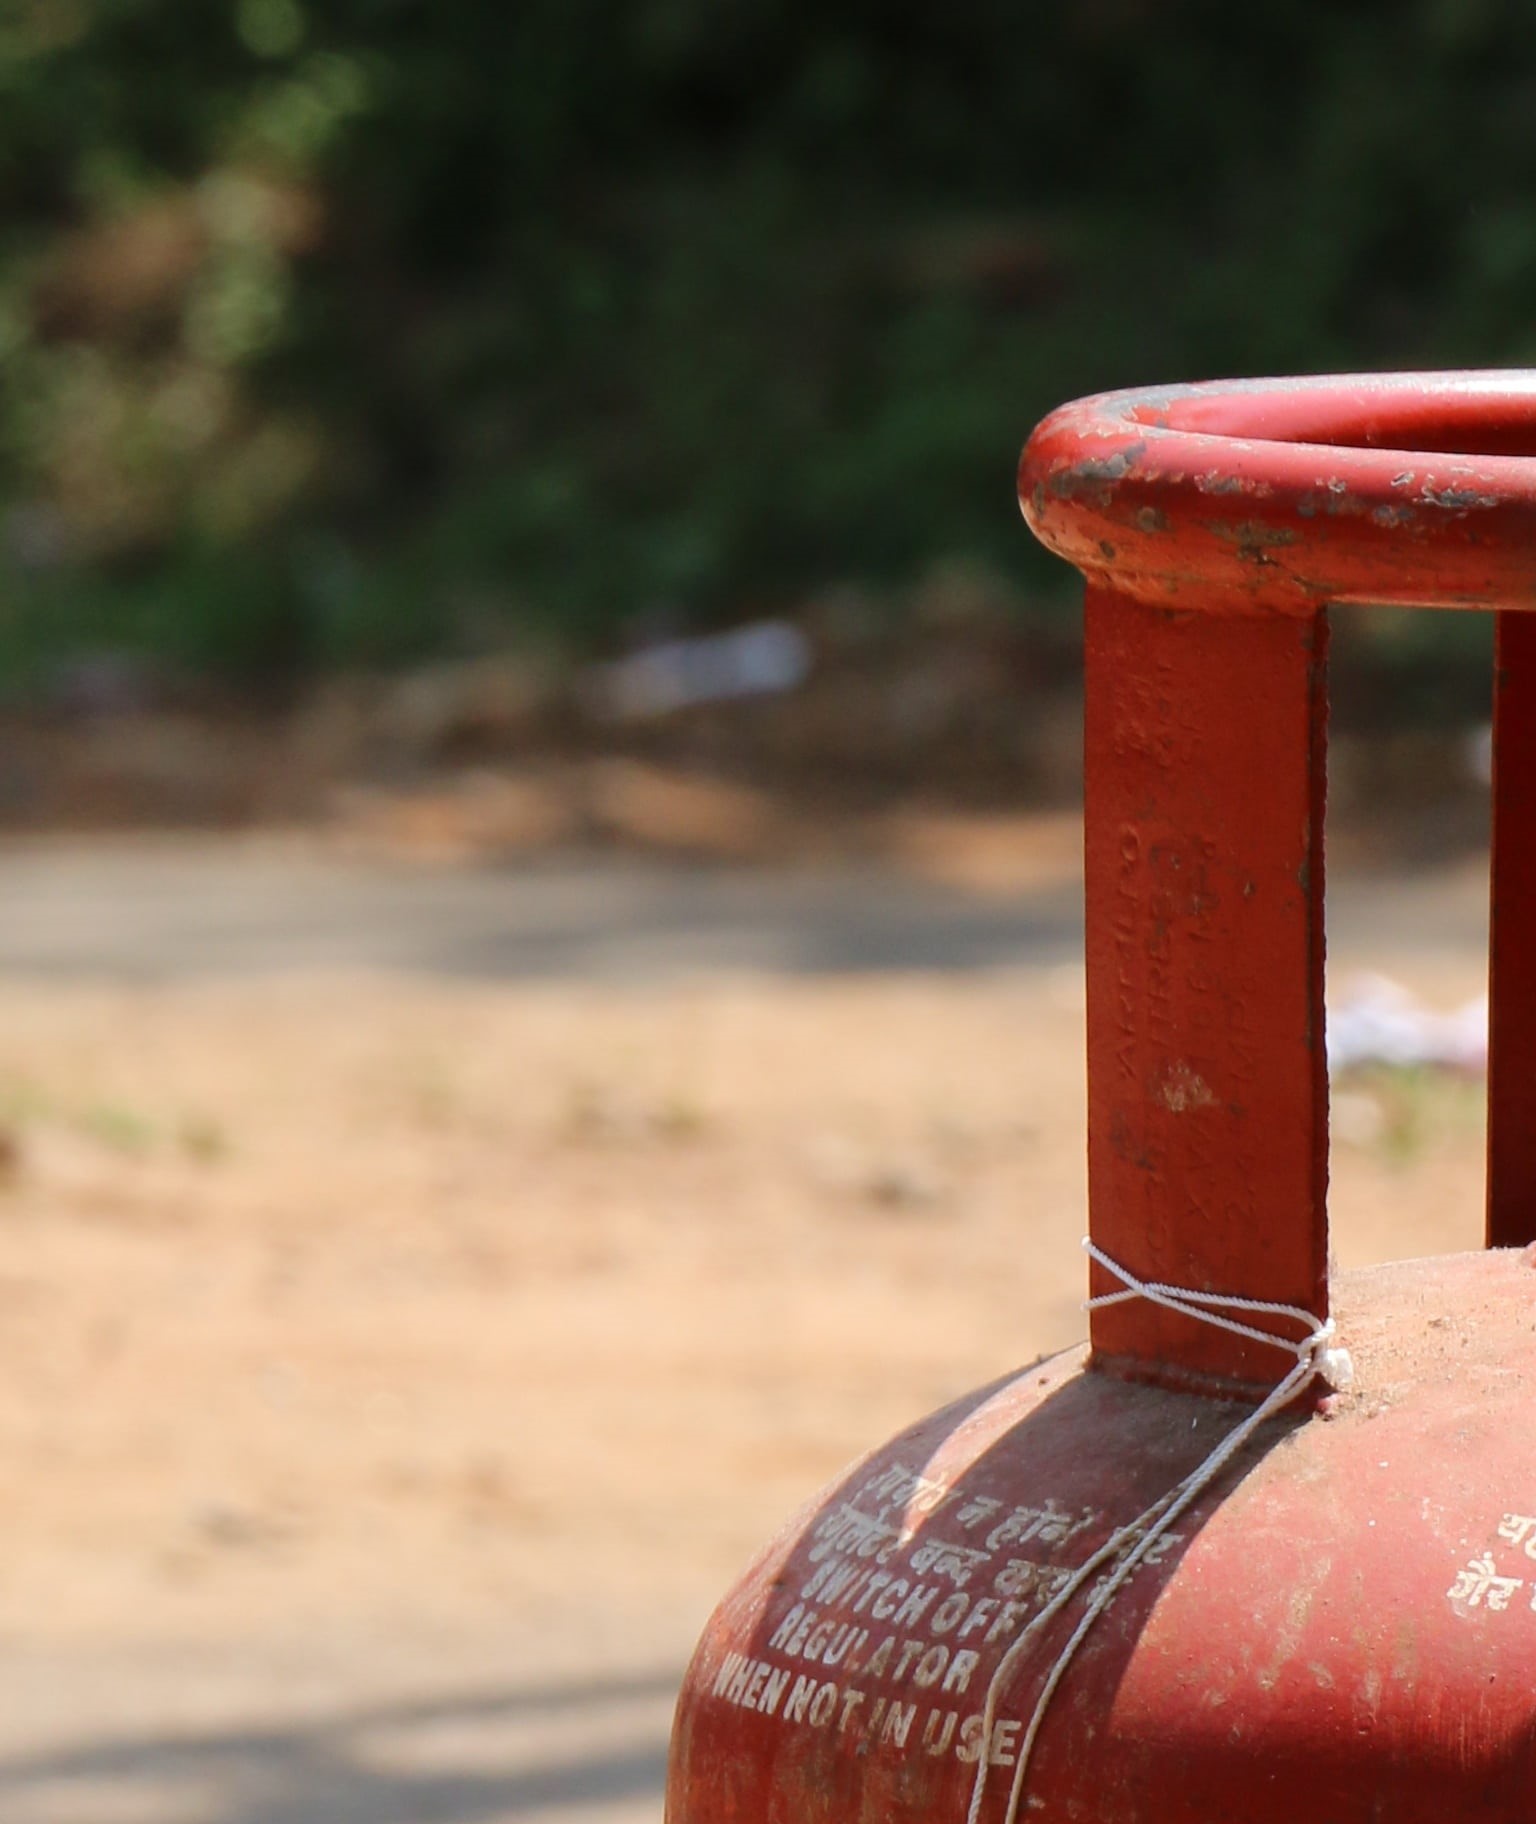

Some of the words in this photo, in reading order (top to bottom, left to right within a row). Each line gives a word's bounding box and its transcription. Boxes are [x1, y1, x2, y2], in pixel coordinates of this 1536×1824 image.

[800, 1558, 928, 1628] SWITCH
[930, 1592, 1029, 1644] OFF
[713, 1650, 794, 1716] WHEN
[783, 1677, 867, 1732] NOT
[867, 1697, 917, 1749] IN
[921, 1707, 1023, 1768] USE
